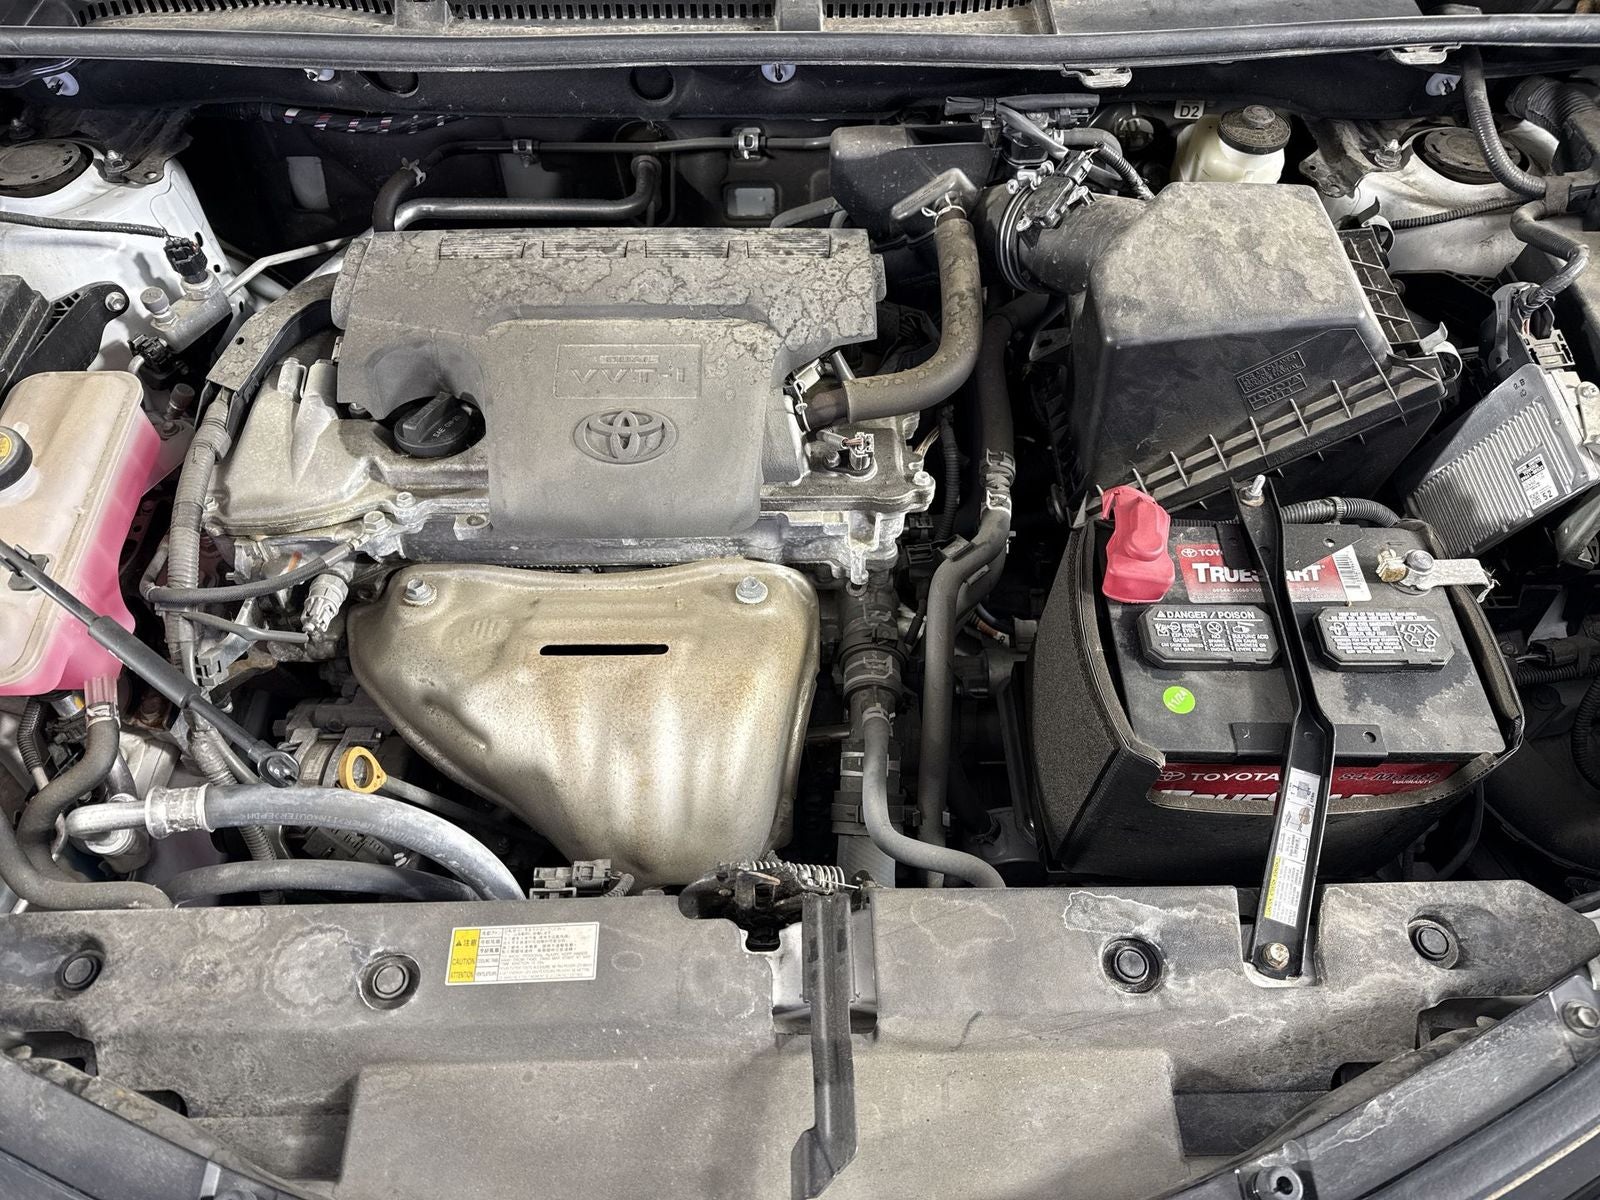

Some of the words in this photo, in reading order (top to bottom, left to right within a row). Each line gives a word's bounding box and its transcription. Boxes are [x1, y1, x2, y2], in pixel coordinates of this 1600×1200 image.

[1180, 105, 1200, 117] D2
[1166, 611, 1208, 619] DANGER
[1217, 611, 1256, 619] POISON
[1191, 772, 1280, 781] TOYOTA
[452, 958, 475, 966] CAUTION
